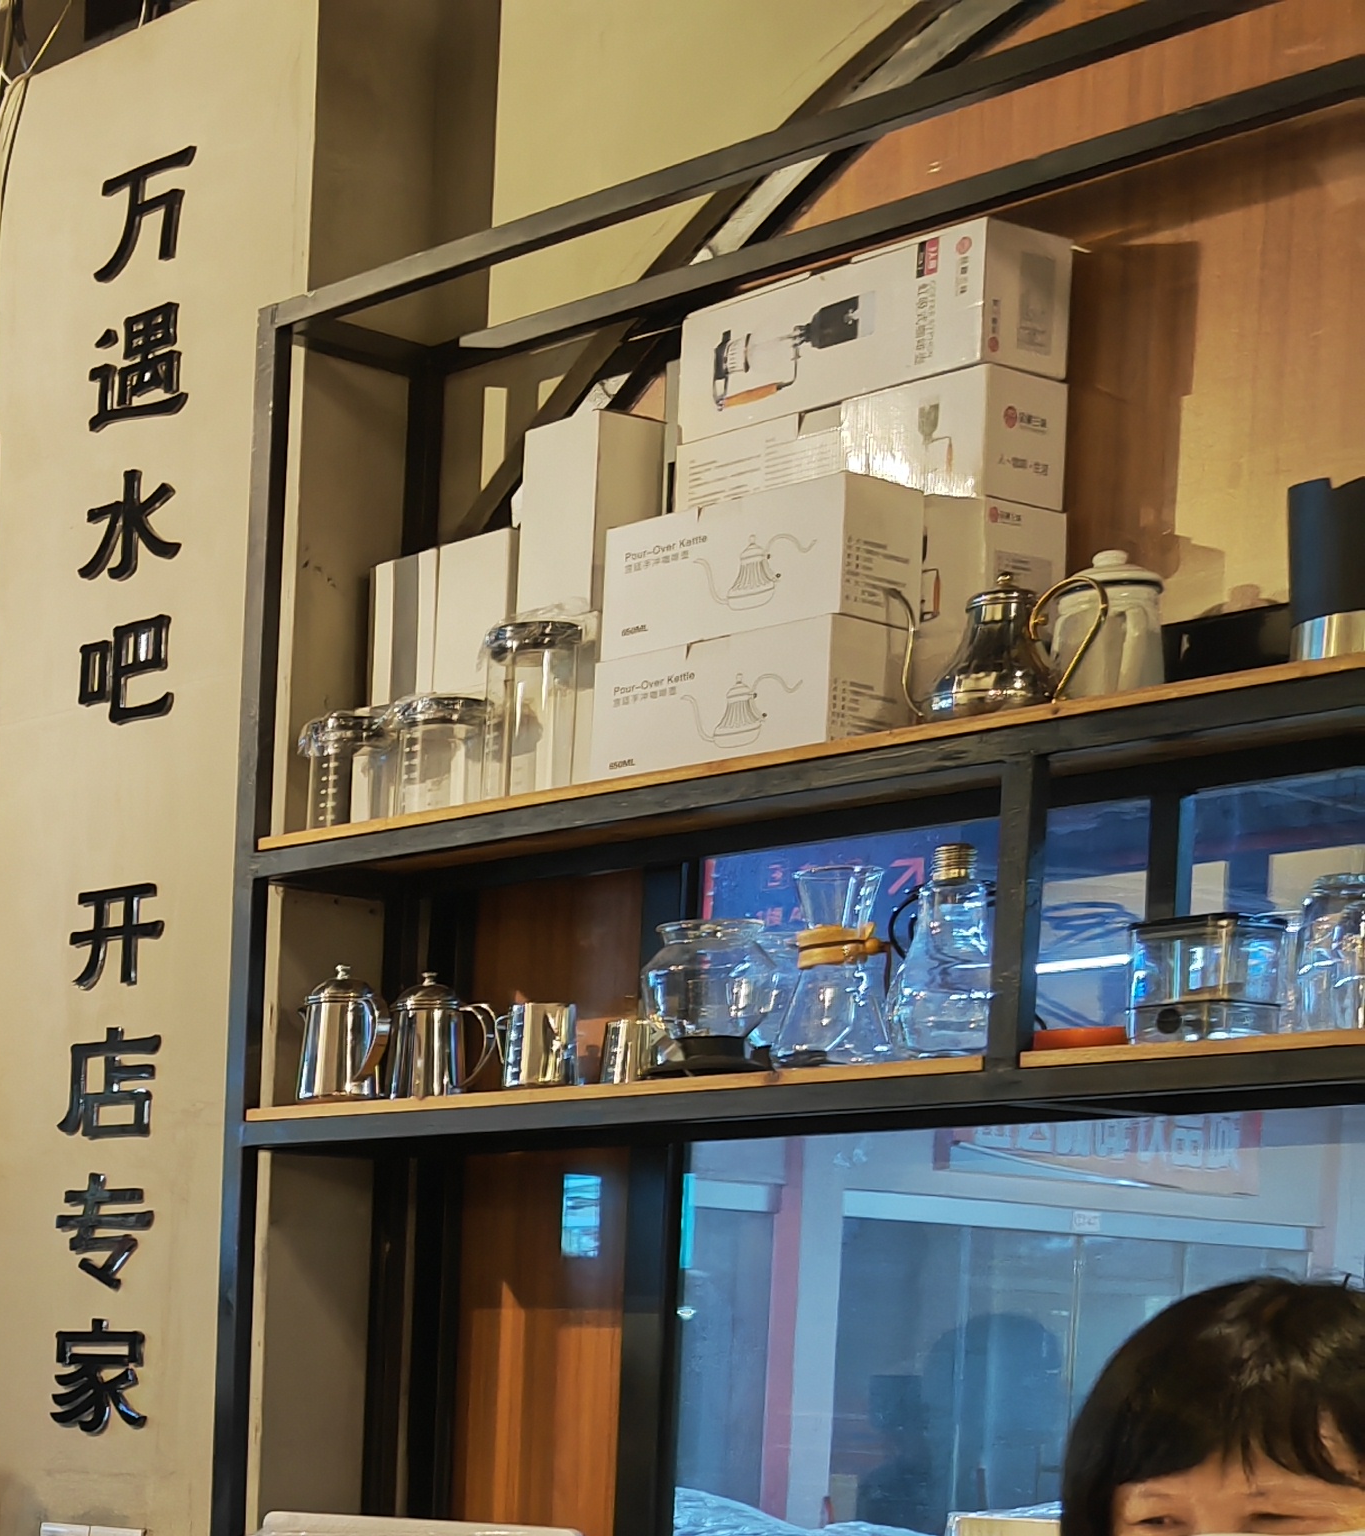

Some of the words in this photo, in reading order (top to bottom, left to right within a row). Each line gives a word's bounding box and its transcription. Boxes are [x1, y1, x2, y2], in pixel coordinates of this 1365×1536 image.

[77, 145, 198, 726] 万遇水吧
[50, 881, 165, 1434] 开店专家
